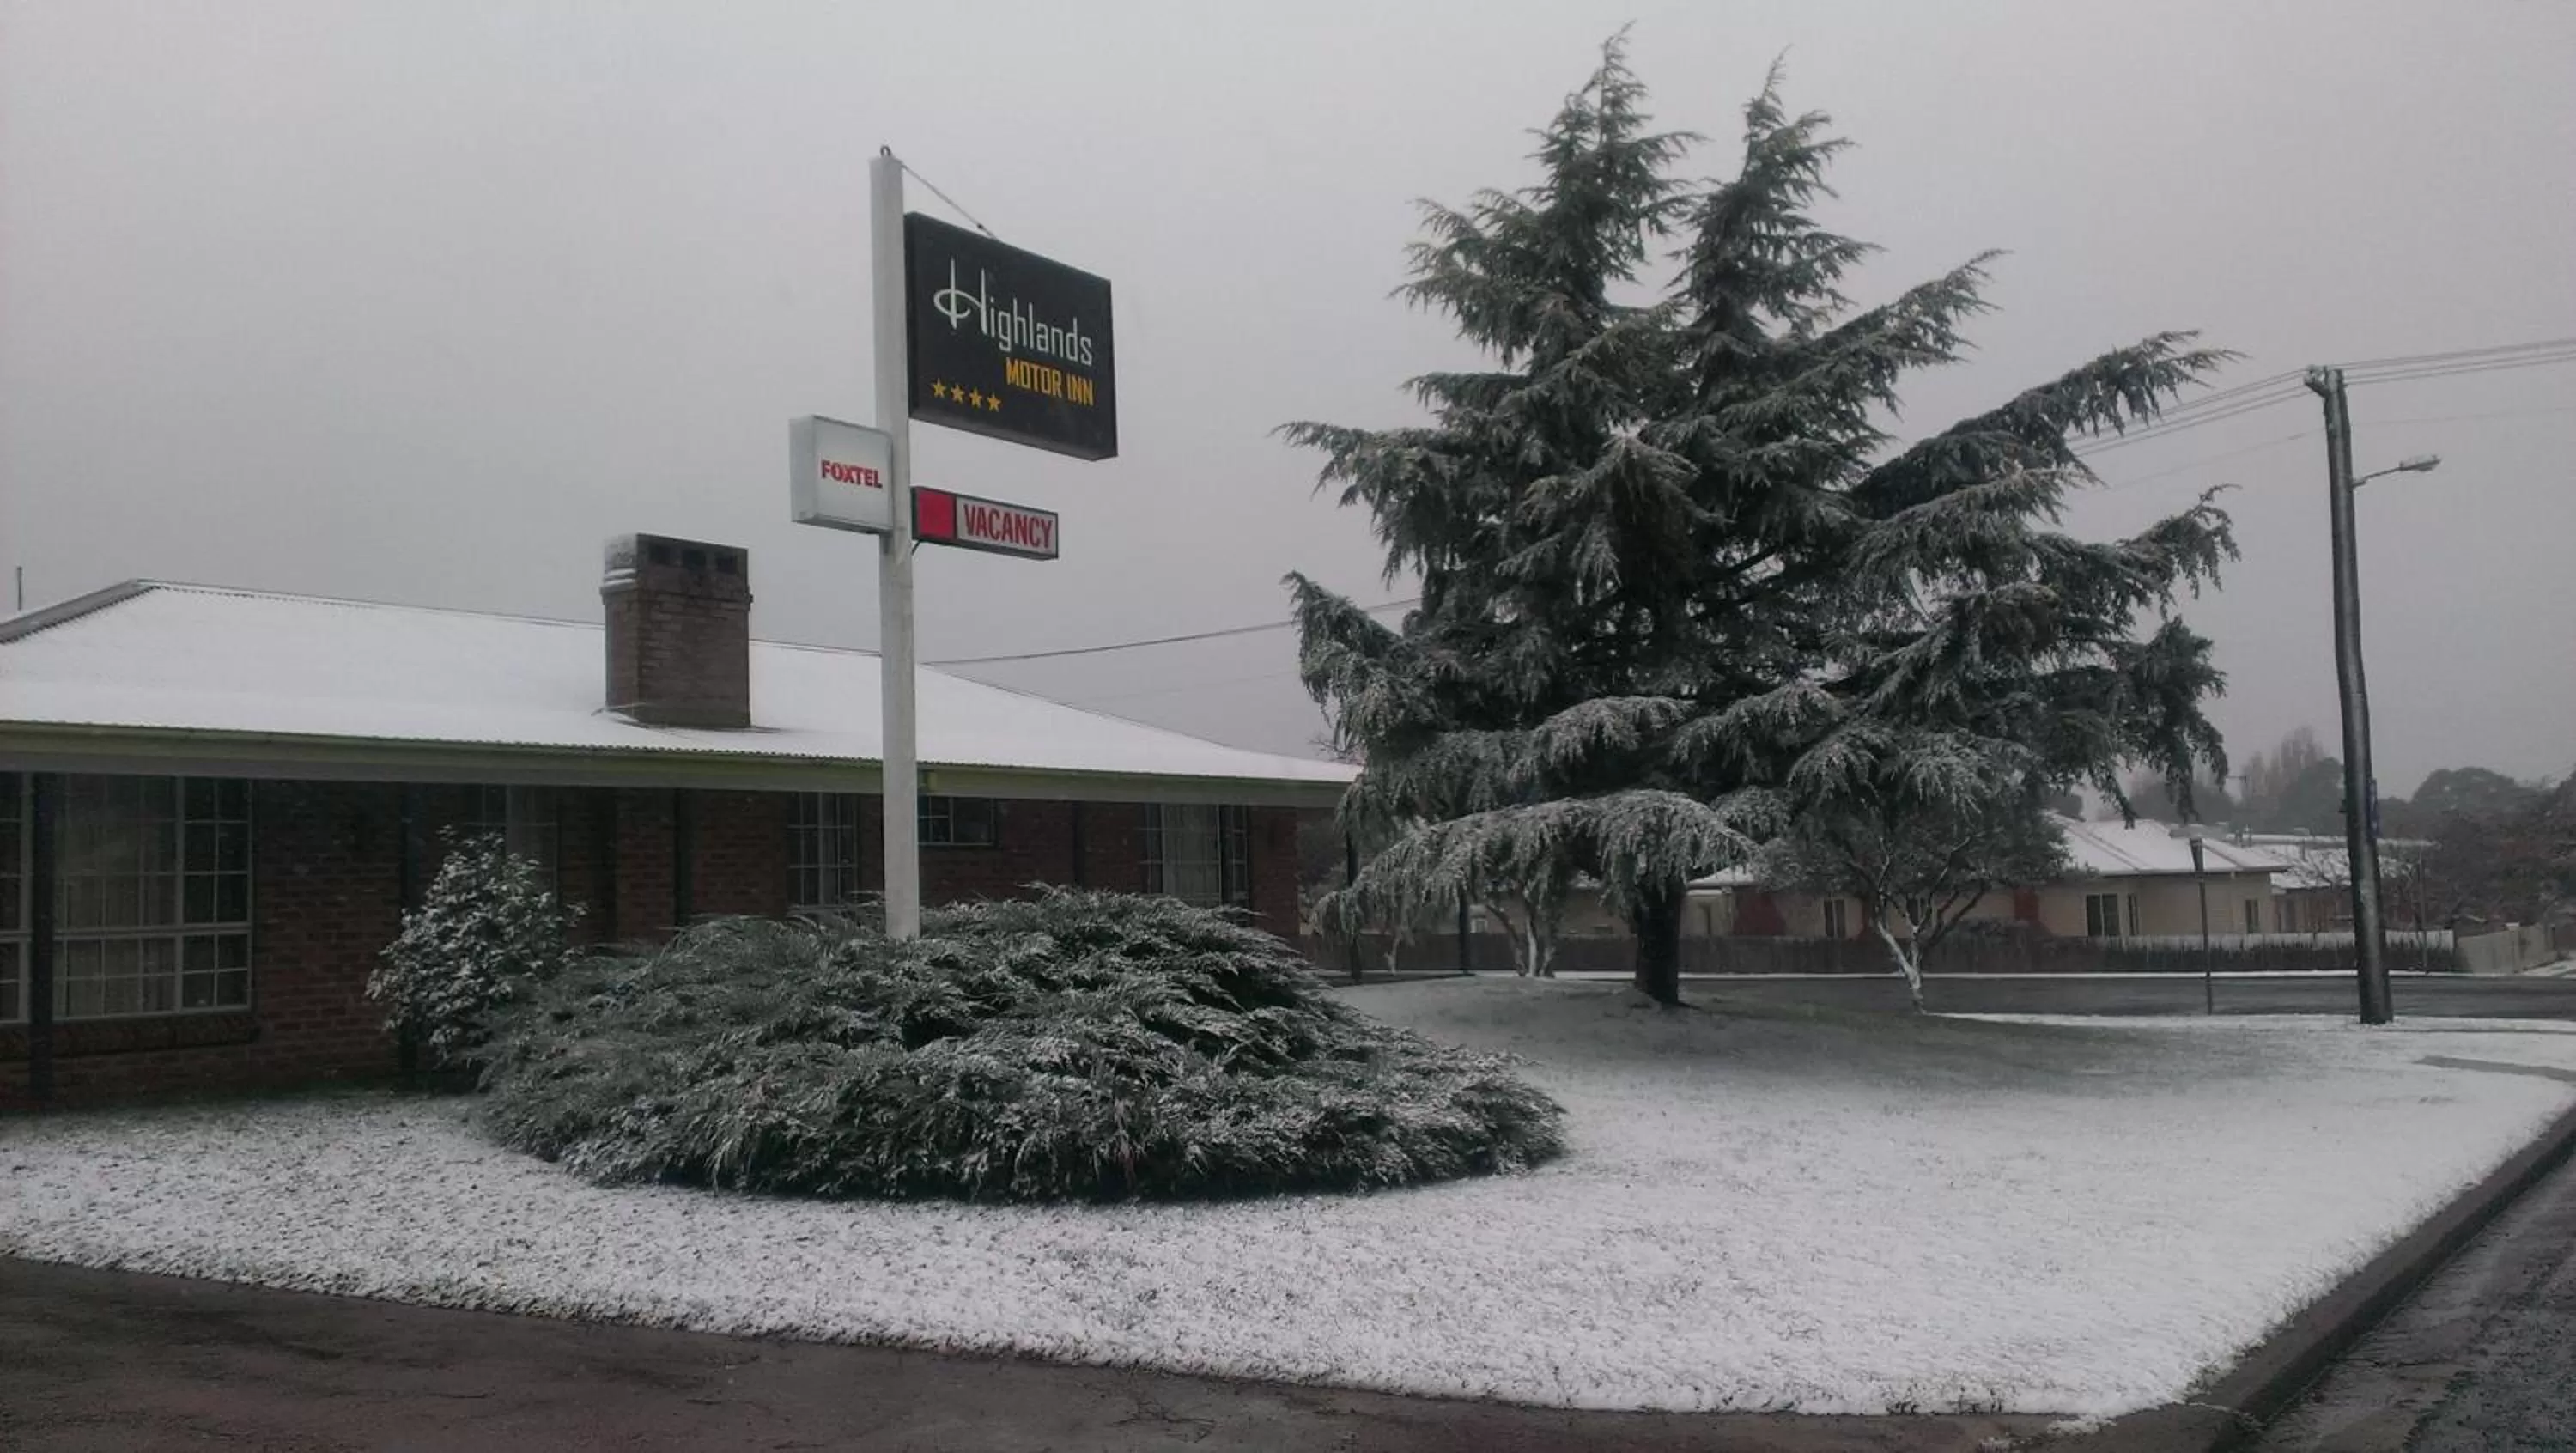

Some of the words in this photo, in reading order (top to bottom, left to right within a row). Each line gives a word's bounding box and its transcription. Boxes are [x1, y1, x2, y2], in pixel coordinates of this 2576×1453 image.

[933, 257, 1092, 366] Highlands
[1005, 357, 1062, 398] MOTOR
[1067, 374, 1094, 406] INN
[821, 459, 883, 489] FOXTEL
[963, 503, 1053, 550] VACANCY
